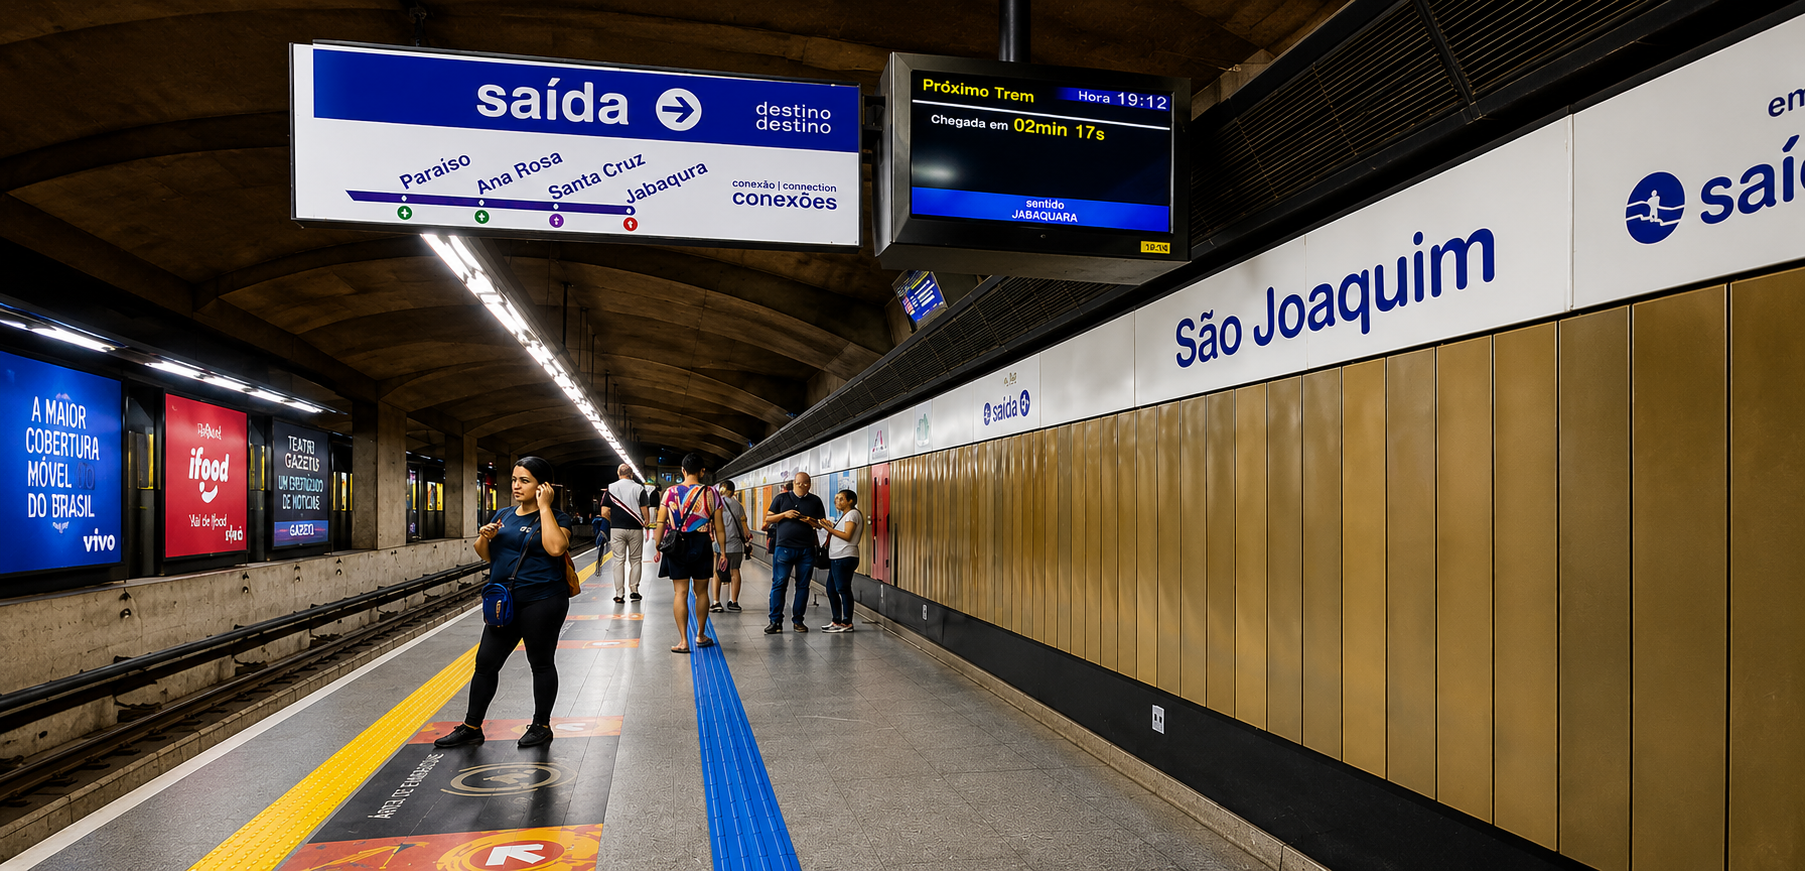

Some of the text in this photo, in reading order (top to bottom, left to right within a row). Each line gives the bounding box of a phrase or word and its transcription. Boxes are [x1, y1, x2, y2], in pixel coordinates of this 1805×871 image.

[476, 77, 629, 125] saída
[923, 78, 1034, 103] Próximo Trem
[1078, 90, 1167, 110] Hora 19:12
[756, 101, 831, 120] destino
[756, 116, 831, 134] destino
[931, 114, 1106, 141] Chegada em 02min 17s
[477, 151, 564, 195] Ana Rosa
[548, 153, 646, 200] Santa Cruz
[625, 161, 710, 204] Jabaqura
[1700, 134, 1805, 224] saí
[732, 191, 838, 210] conexões
[783, 183, 837, 193] connection
[1011, 209, 1078, 223] JABAQUARA
[1025, 199, 1065, 210] sentido
[1175, 228, 1496, 368] São Joaquim
[31, 396, 87, 430] A MAIOR
[26, 427, 100, 461] COBERTURA
[28, 456, 73, 489] MÓVEL
[188, 447, 230, 482] ifood
[28, 493, 47, 518] DO
[83, 528, 116, 552] vivo
